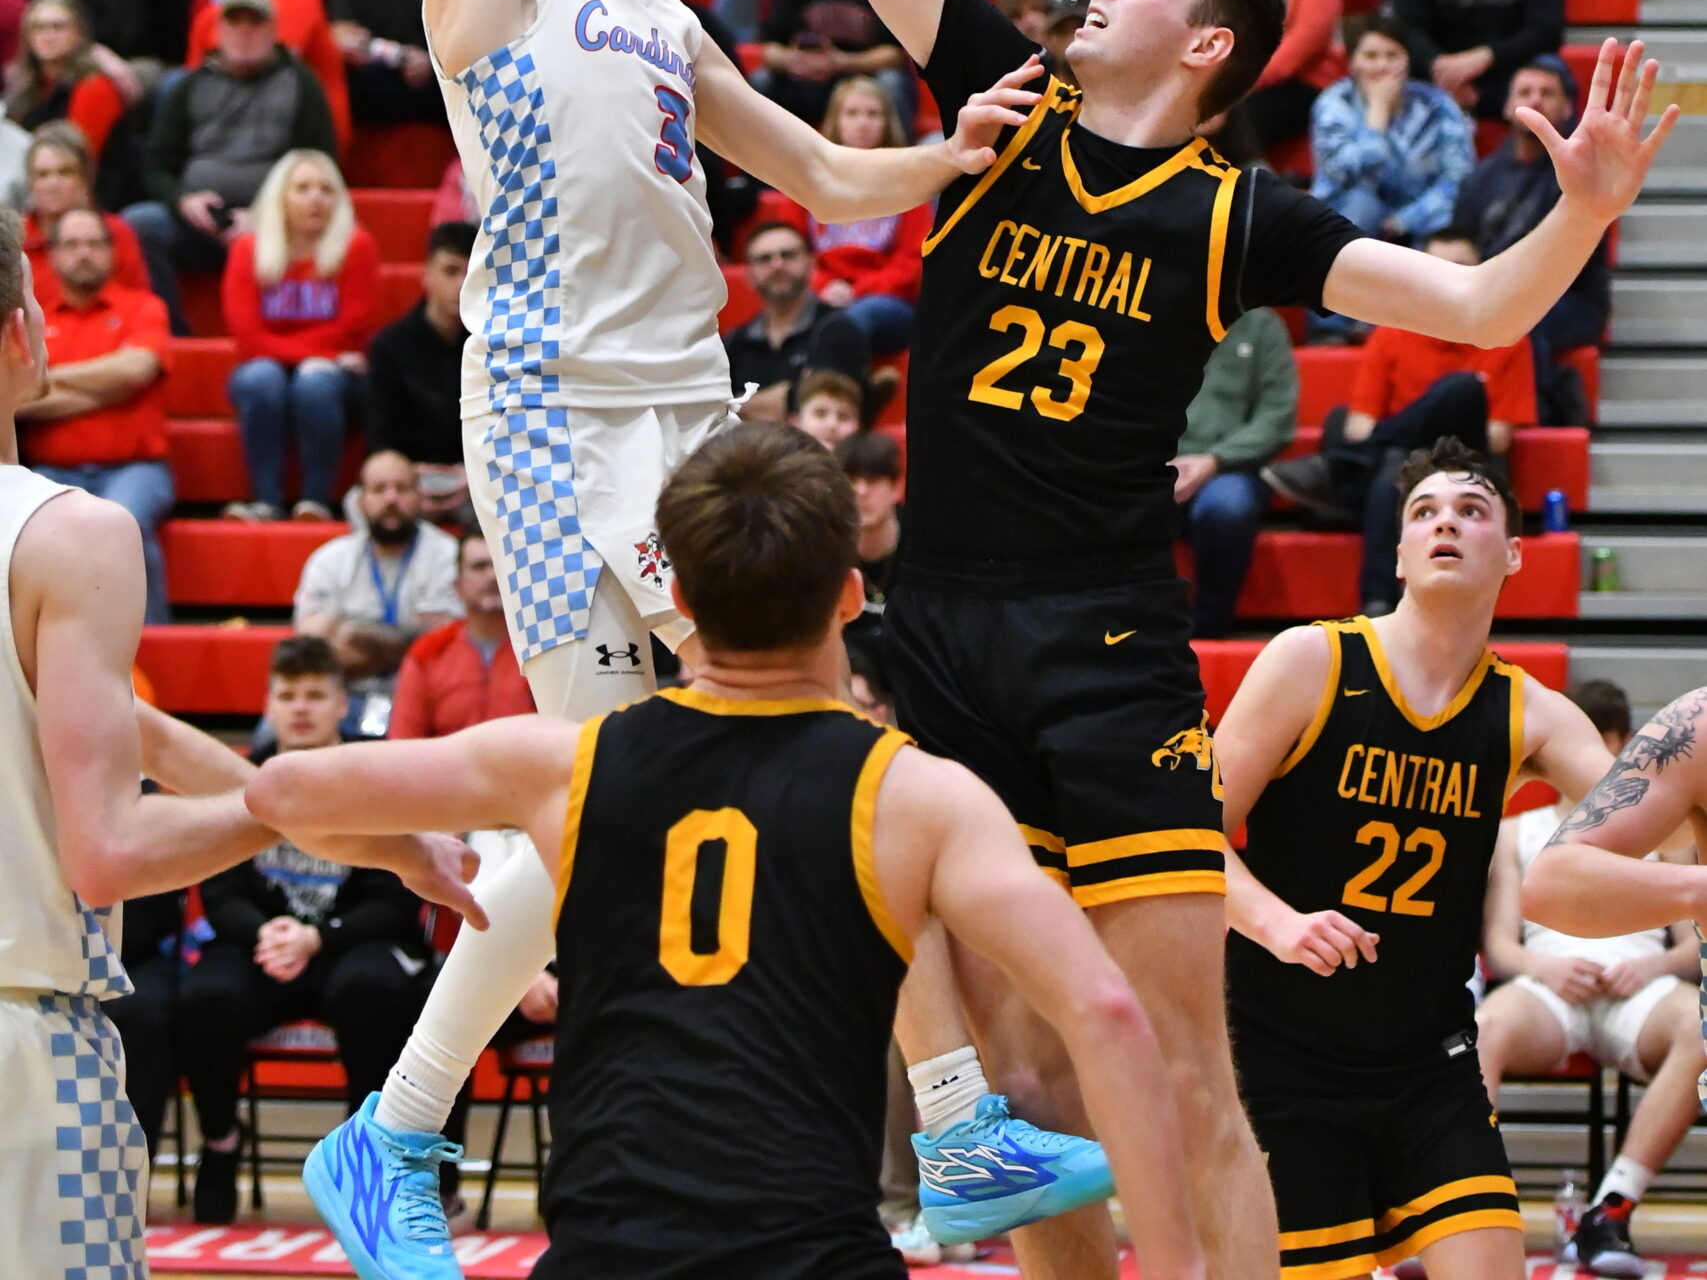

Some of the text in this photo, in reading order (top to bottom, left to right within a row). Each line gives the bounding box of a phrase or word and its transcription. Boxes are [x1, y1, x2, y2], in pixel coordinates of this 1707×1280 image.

[575, 0, 697, 96] Cardina
[654, 85, 693, 184] 3
[979, 220, 1153, 322] CENTRAL
[968, 305, 1106, 422] 23
[1338, 744, 1481, 818] CENTRAL
[659, 807, 758, 986] 0
[1342, 821, 1447, 917] 22
